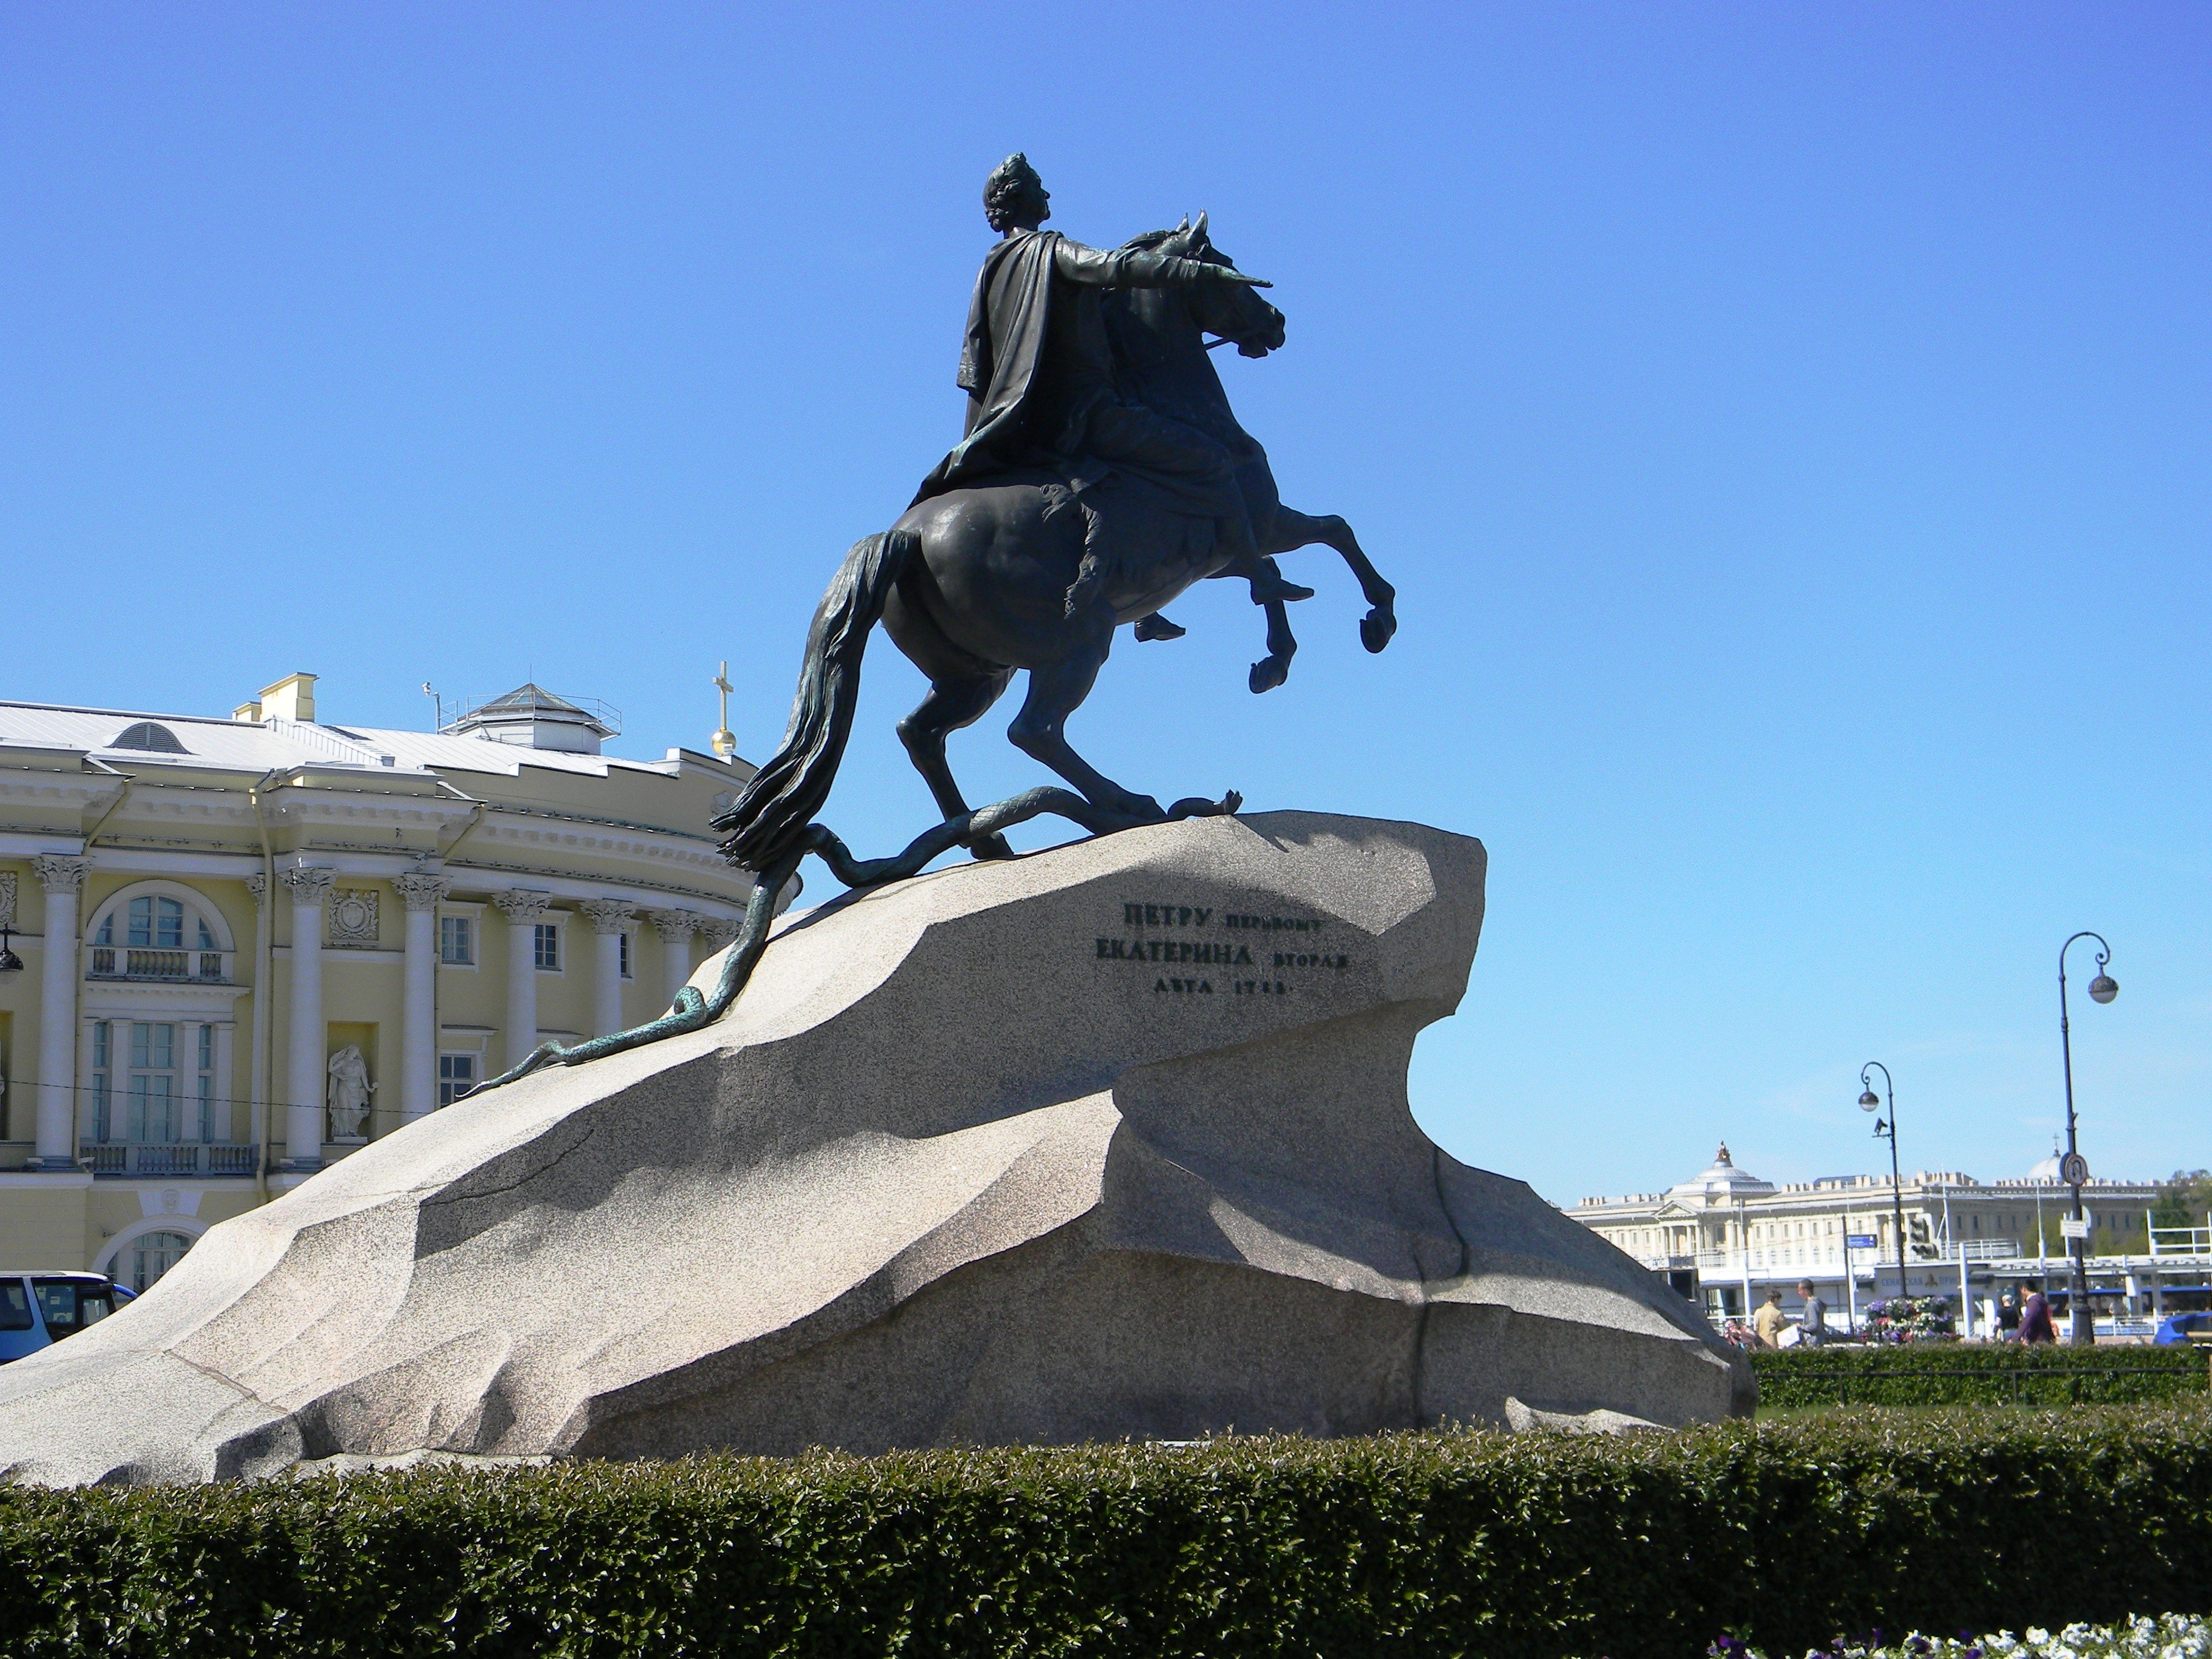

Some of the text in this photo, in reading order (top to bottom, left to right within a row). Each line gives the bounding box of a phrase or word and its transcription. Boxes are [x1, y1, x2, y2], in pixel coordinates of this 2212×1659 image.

[1123, 902, 1213, 927] ПЕТРУ
[1095, 938, 1348, 969] ЕКАТЕРИНА ВТОРАЯ
